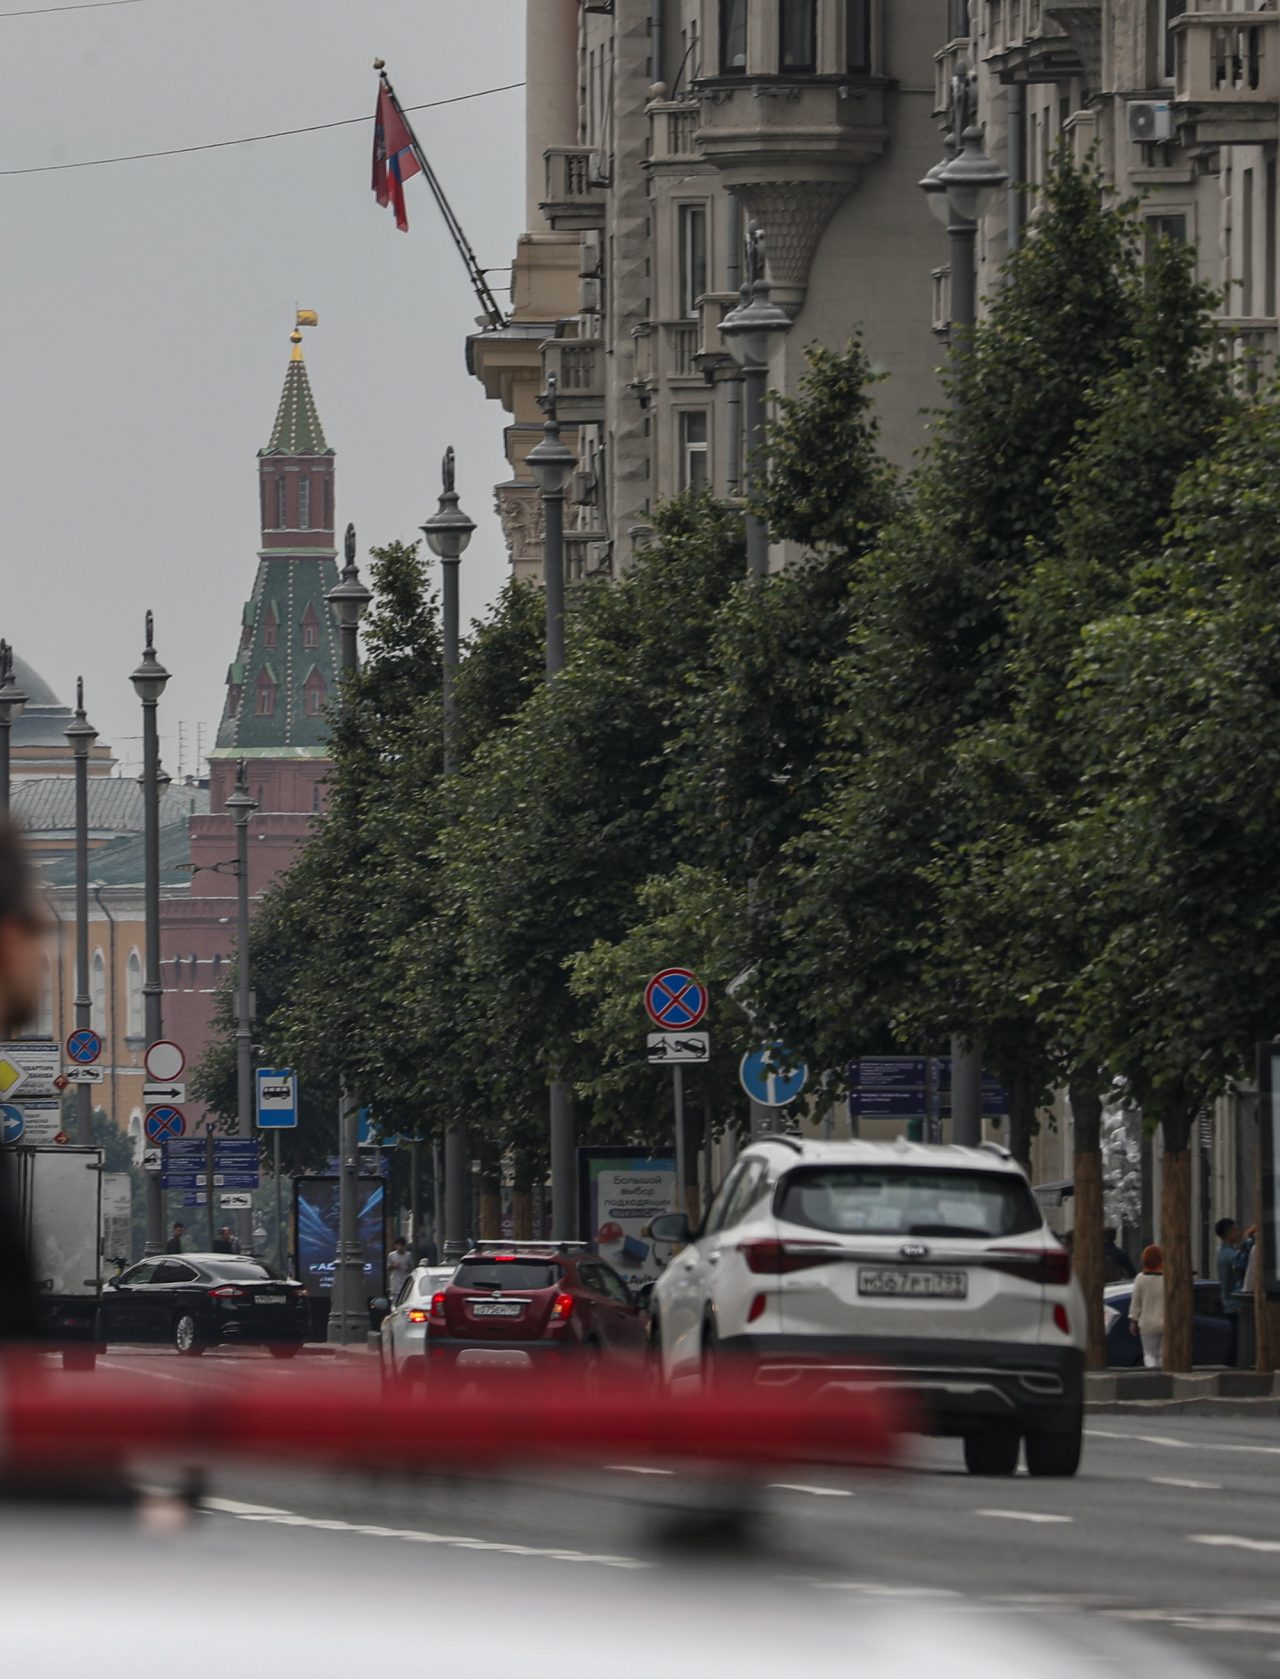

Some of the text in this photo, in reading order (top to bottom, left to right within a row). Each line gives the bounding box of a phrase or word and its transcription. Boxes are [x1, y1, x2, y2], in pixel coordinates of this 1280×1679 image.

[613, 1175, 663, 1185] Большой
[620, 1186, 656, 1196] выбор
[604, 1199, 671, 1207] подходящих
